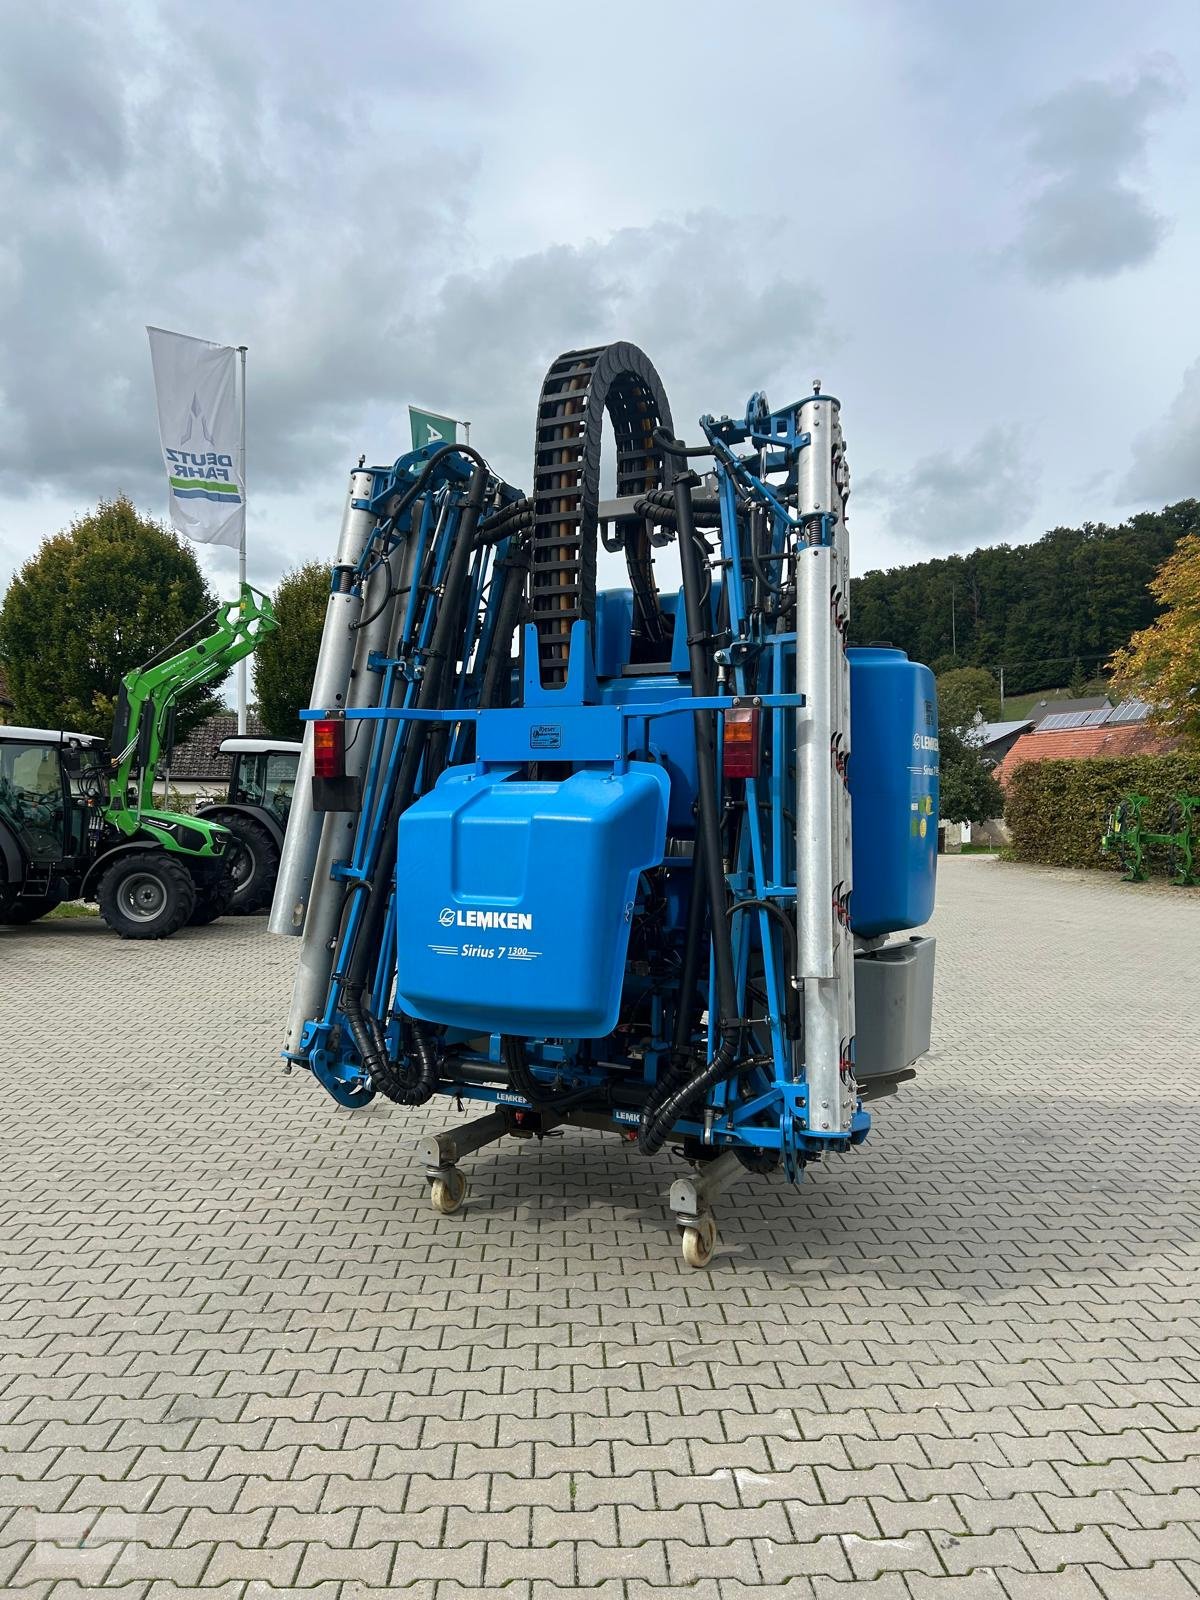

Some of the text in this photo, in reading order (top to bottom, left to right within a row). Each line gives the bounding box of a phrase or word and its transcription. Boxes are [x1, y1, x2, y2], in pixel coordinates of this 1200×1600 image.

[456, 910, 533, 932] LEMKEN
[460, 943, 528, 959] Sirius 7 1300
[615, 1111, 641, 1123] LEMK
